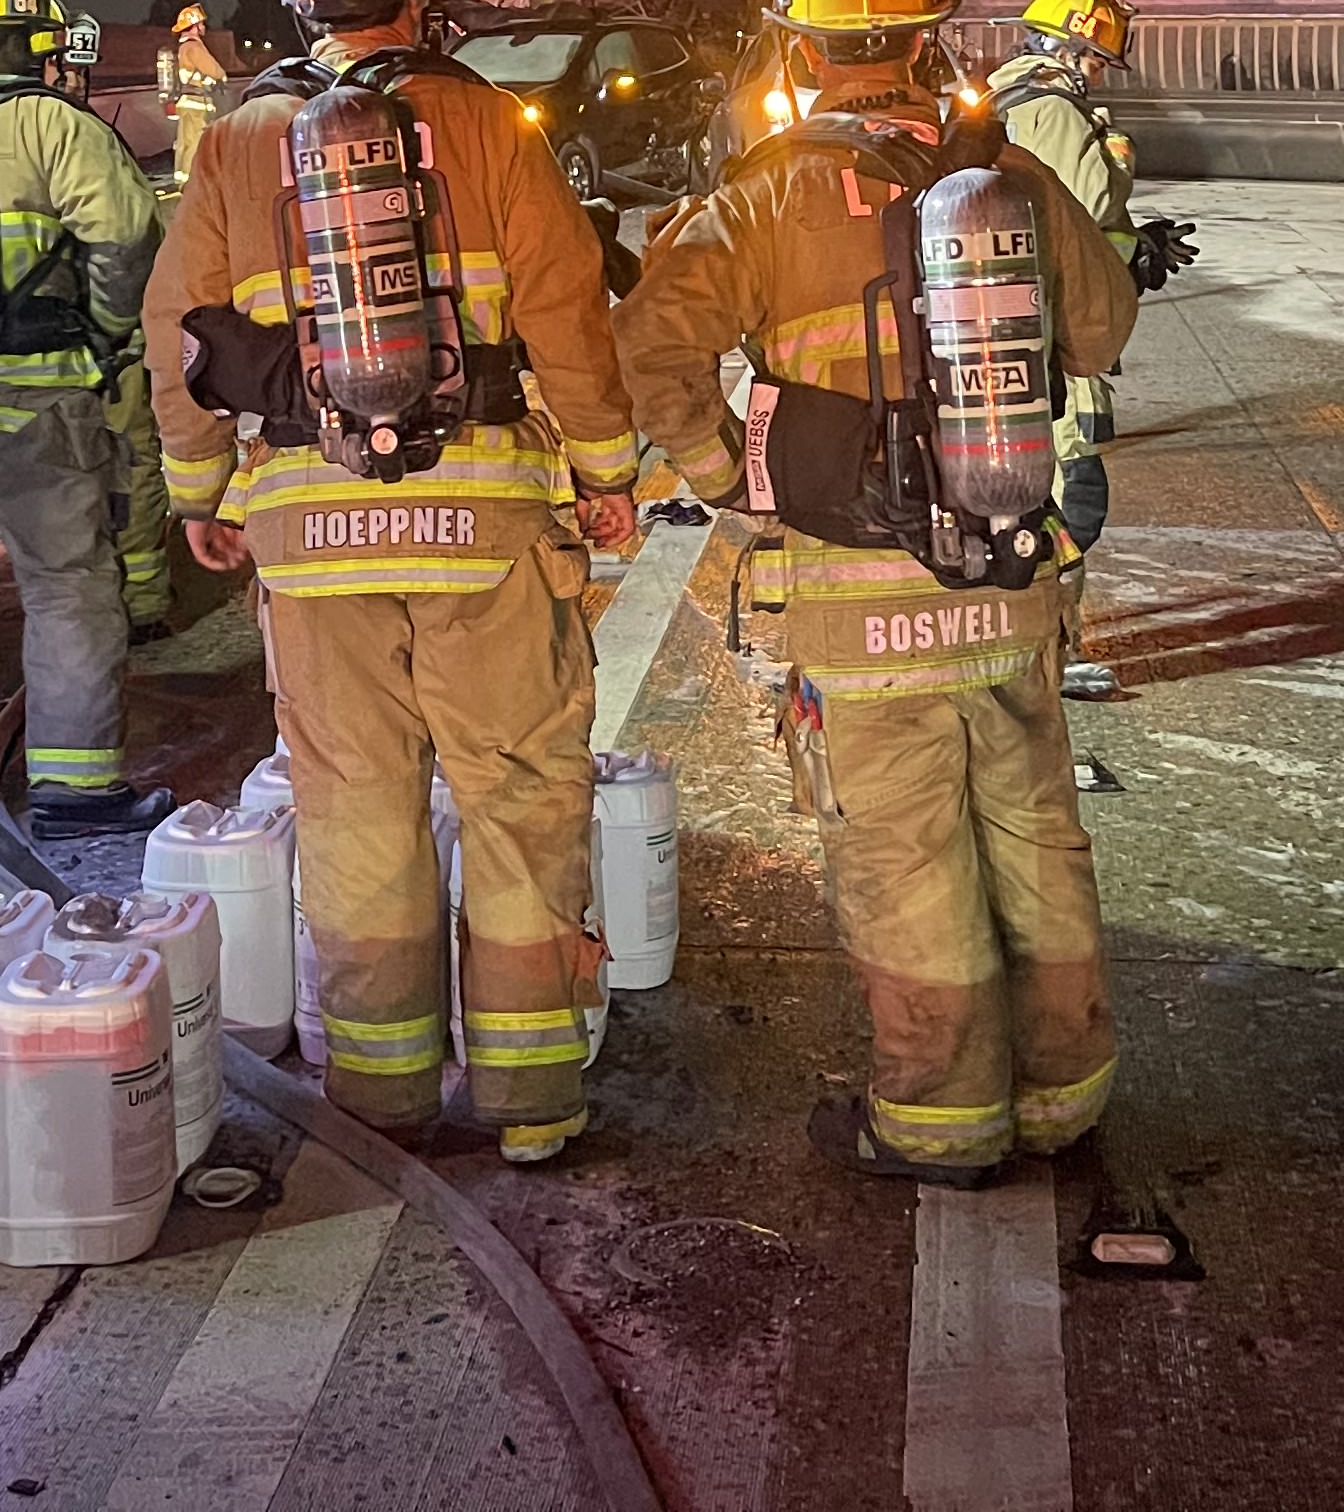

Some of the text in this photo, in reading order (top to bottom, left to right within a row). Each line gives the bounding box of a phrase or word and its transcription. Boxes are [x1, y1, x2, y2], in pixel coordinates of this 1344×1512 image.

[72, 33, 94, 49] 57
[1068, 11, 1096, 38] 64
[348, 140, 396, 166] LFD
[749, 409, 770, 457] UEBSS
[304, 506, 476, 550] HOEPPNER
[865, 601, 1013, 654] BOSWELL
